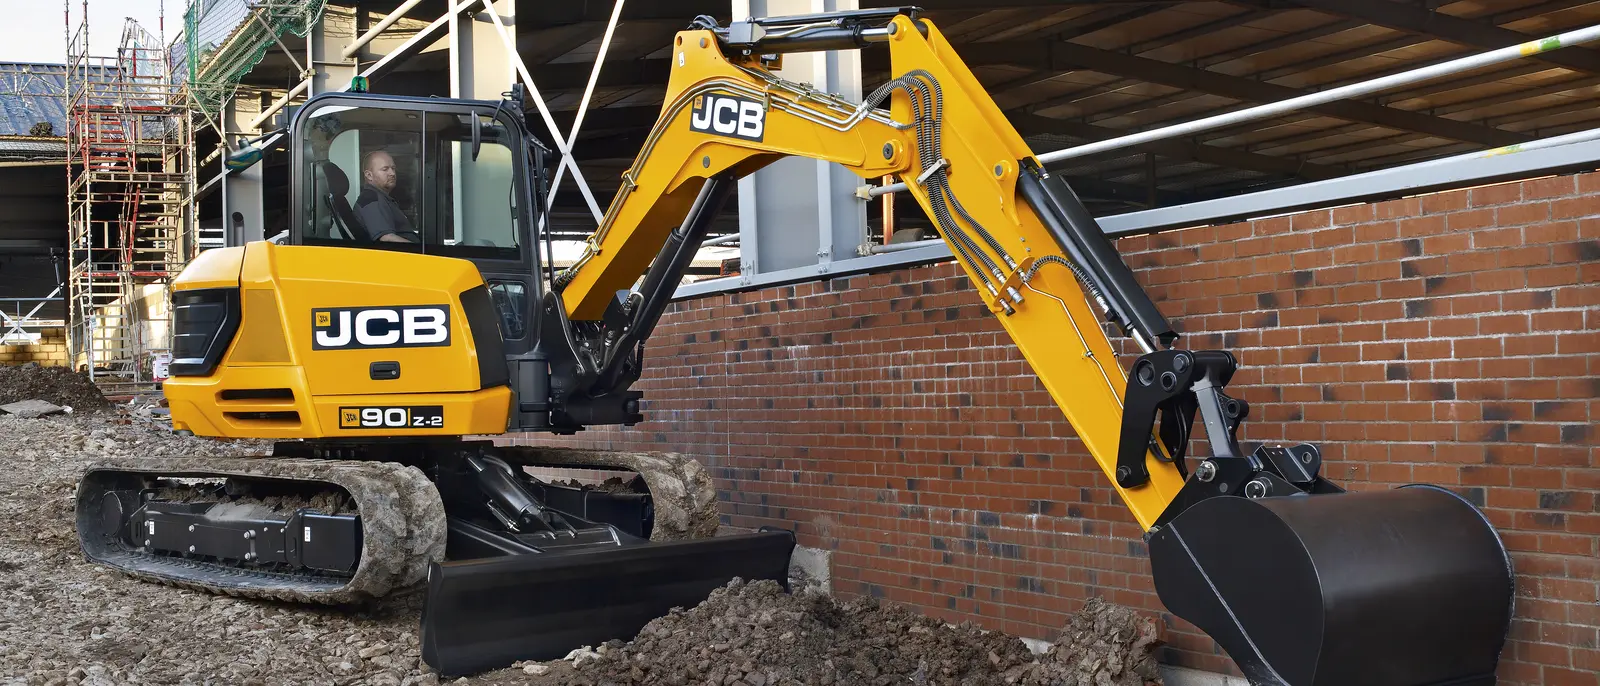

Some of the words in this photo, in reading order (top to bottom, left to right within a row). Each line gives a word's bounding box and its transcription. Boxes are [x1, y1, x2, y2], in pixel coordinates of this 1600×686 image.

[692, 96, 764, 138] JCB
[316, 308, 448, 347] JCB
[361, 408, 407, 427] 90
[412, 416, 443, 426] Z-2
